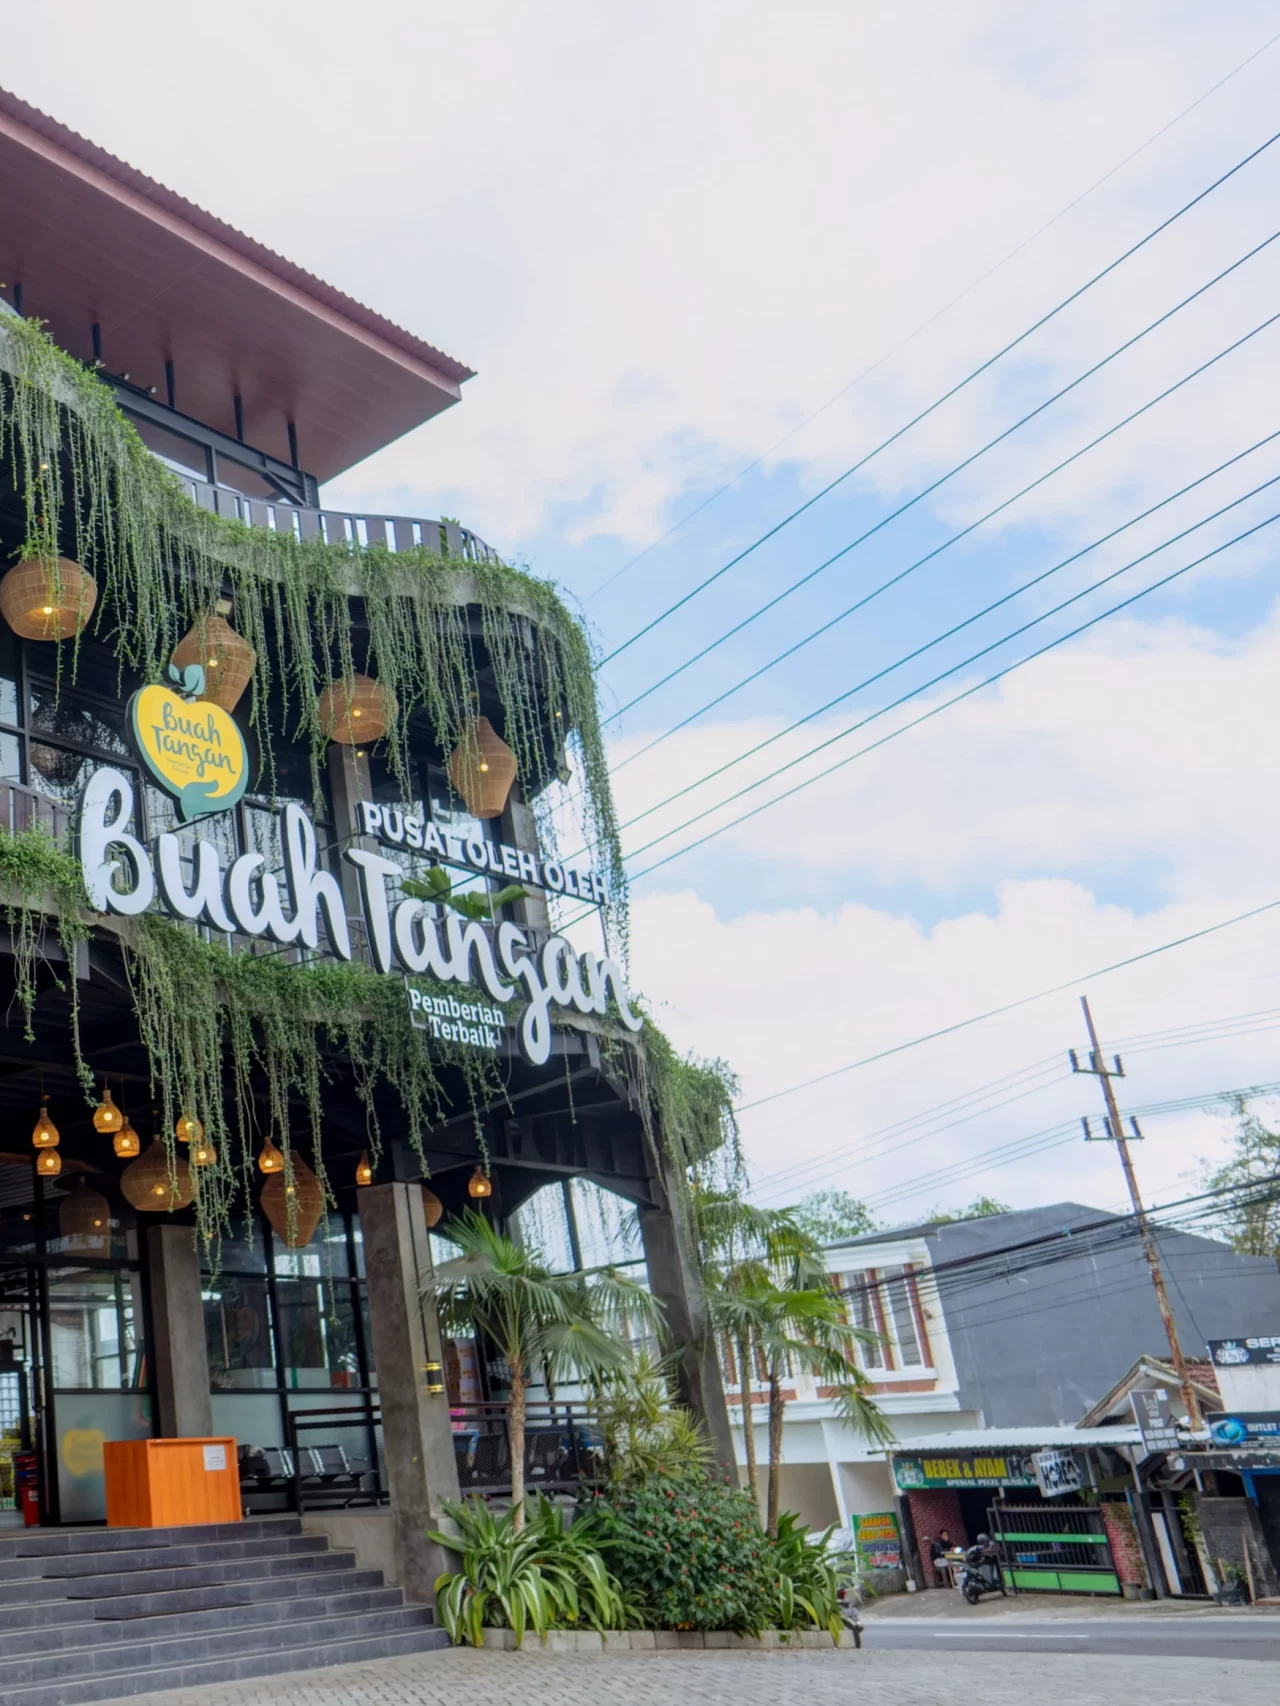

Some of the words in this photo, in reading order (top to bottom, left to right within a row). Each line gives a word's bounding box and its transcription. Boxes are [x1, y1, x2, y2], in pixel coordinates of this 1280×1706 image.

[162, 701, 221, 748] Buah
[151, 725, 236, 778] Tangan
[362, 800, 456, 859] PUSAT
[466, 837, 540, 884] OLEH
[544, 859, 610, 903] OLEH
[80, 766, 351, 962] Buah
[344, 848, 644, 1066] Tangan
[409, 988, 506, 1027] Pemberian
[427, 1015, 496, 1049] Terbaik
[923, 1459, 962, 1479] BEBEK
[963, 1460, 973, 1478] &
[974, 1458, 1008, 1478] AYAM
